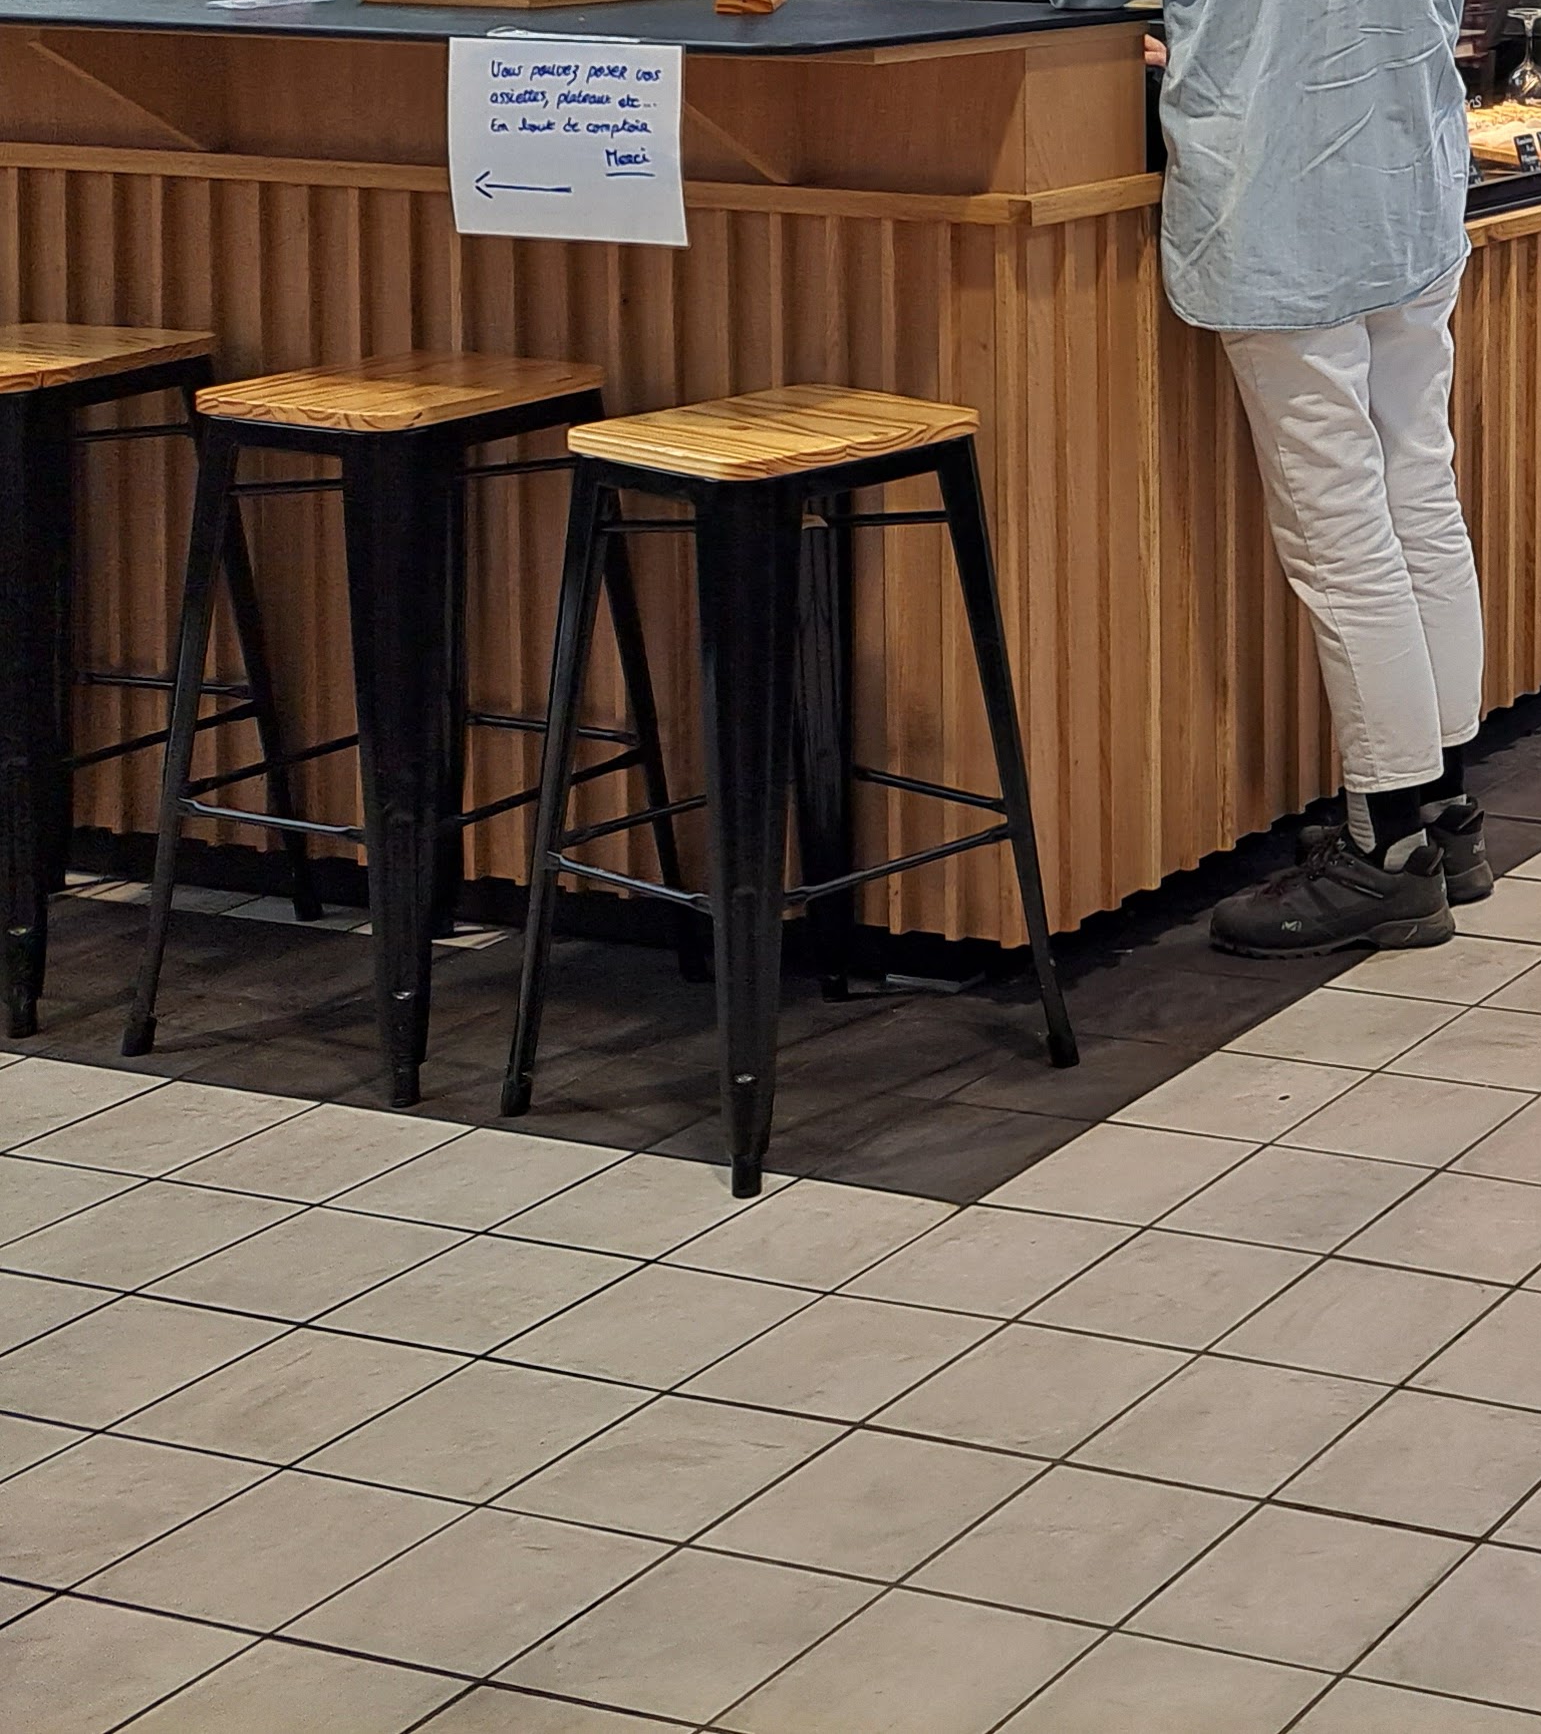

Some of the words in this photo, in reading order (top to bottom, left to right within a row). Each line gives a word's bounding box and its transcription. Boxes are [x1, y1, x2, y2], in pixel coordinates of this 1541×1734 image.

[491, 60, 521, 78] Vous
[530, 63, 580, 86] pouvez
[636, 69, 661, 81] vos
[490, 88, 550, 109] assiettes,
[556, 90, 612, 109] plateaux
[490, 118, 509, 133] En
[563, 117, 582, 133] de
[586, 118, 652, 138] comptoir
[605, 147, 651, 167] Merci
